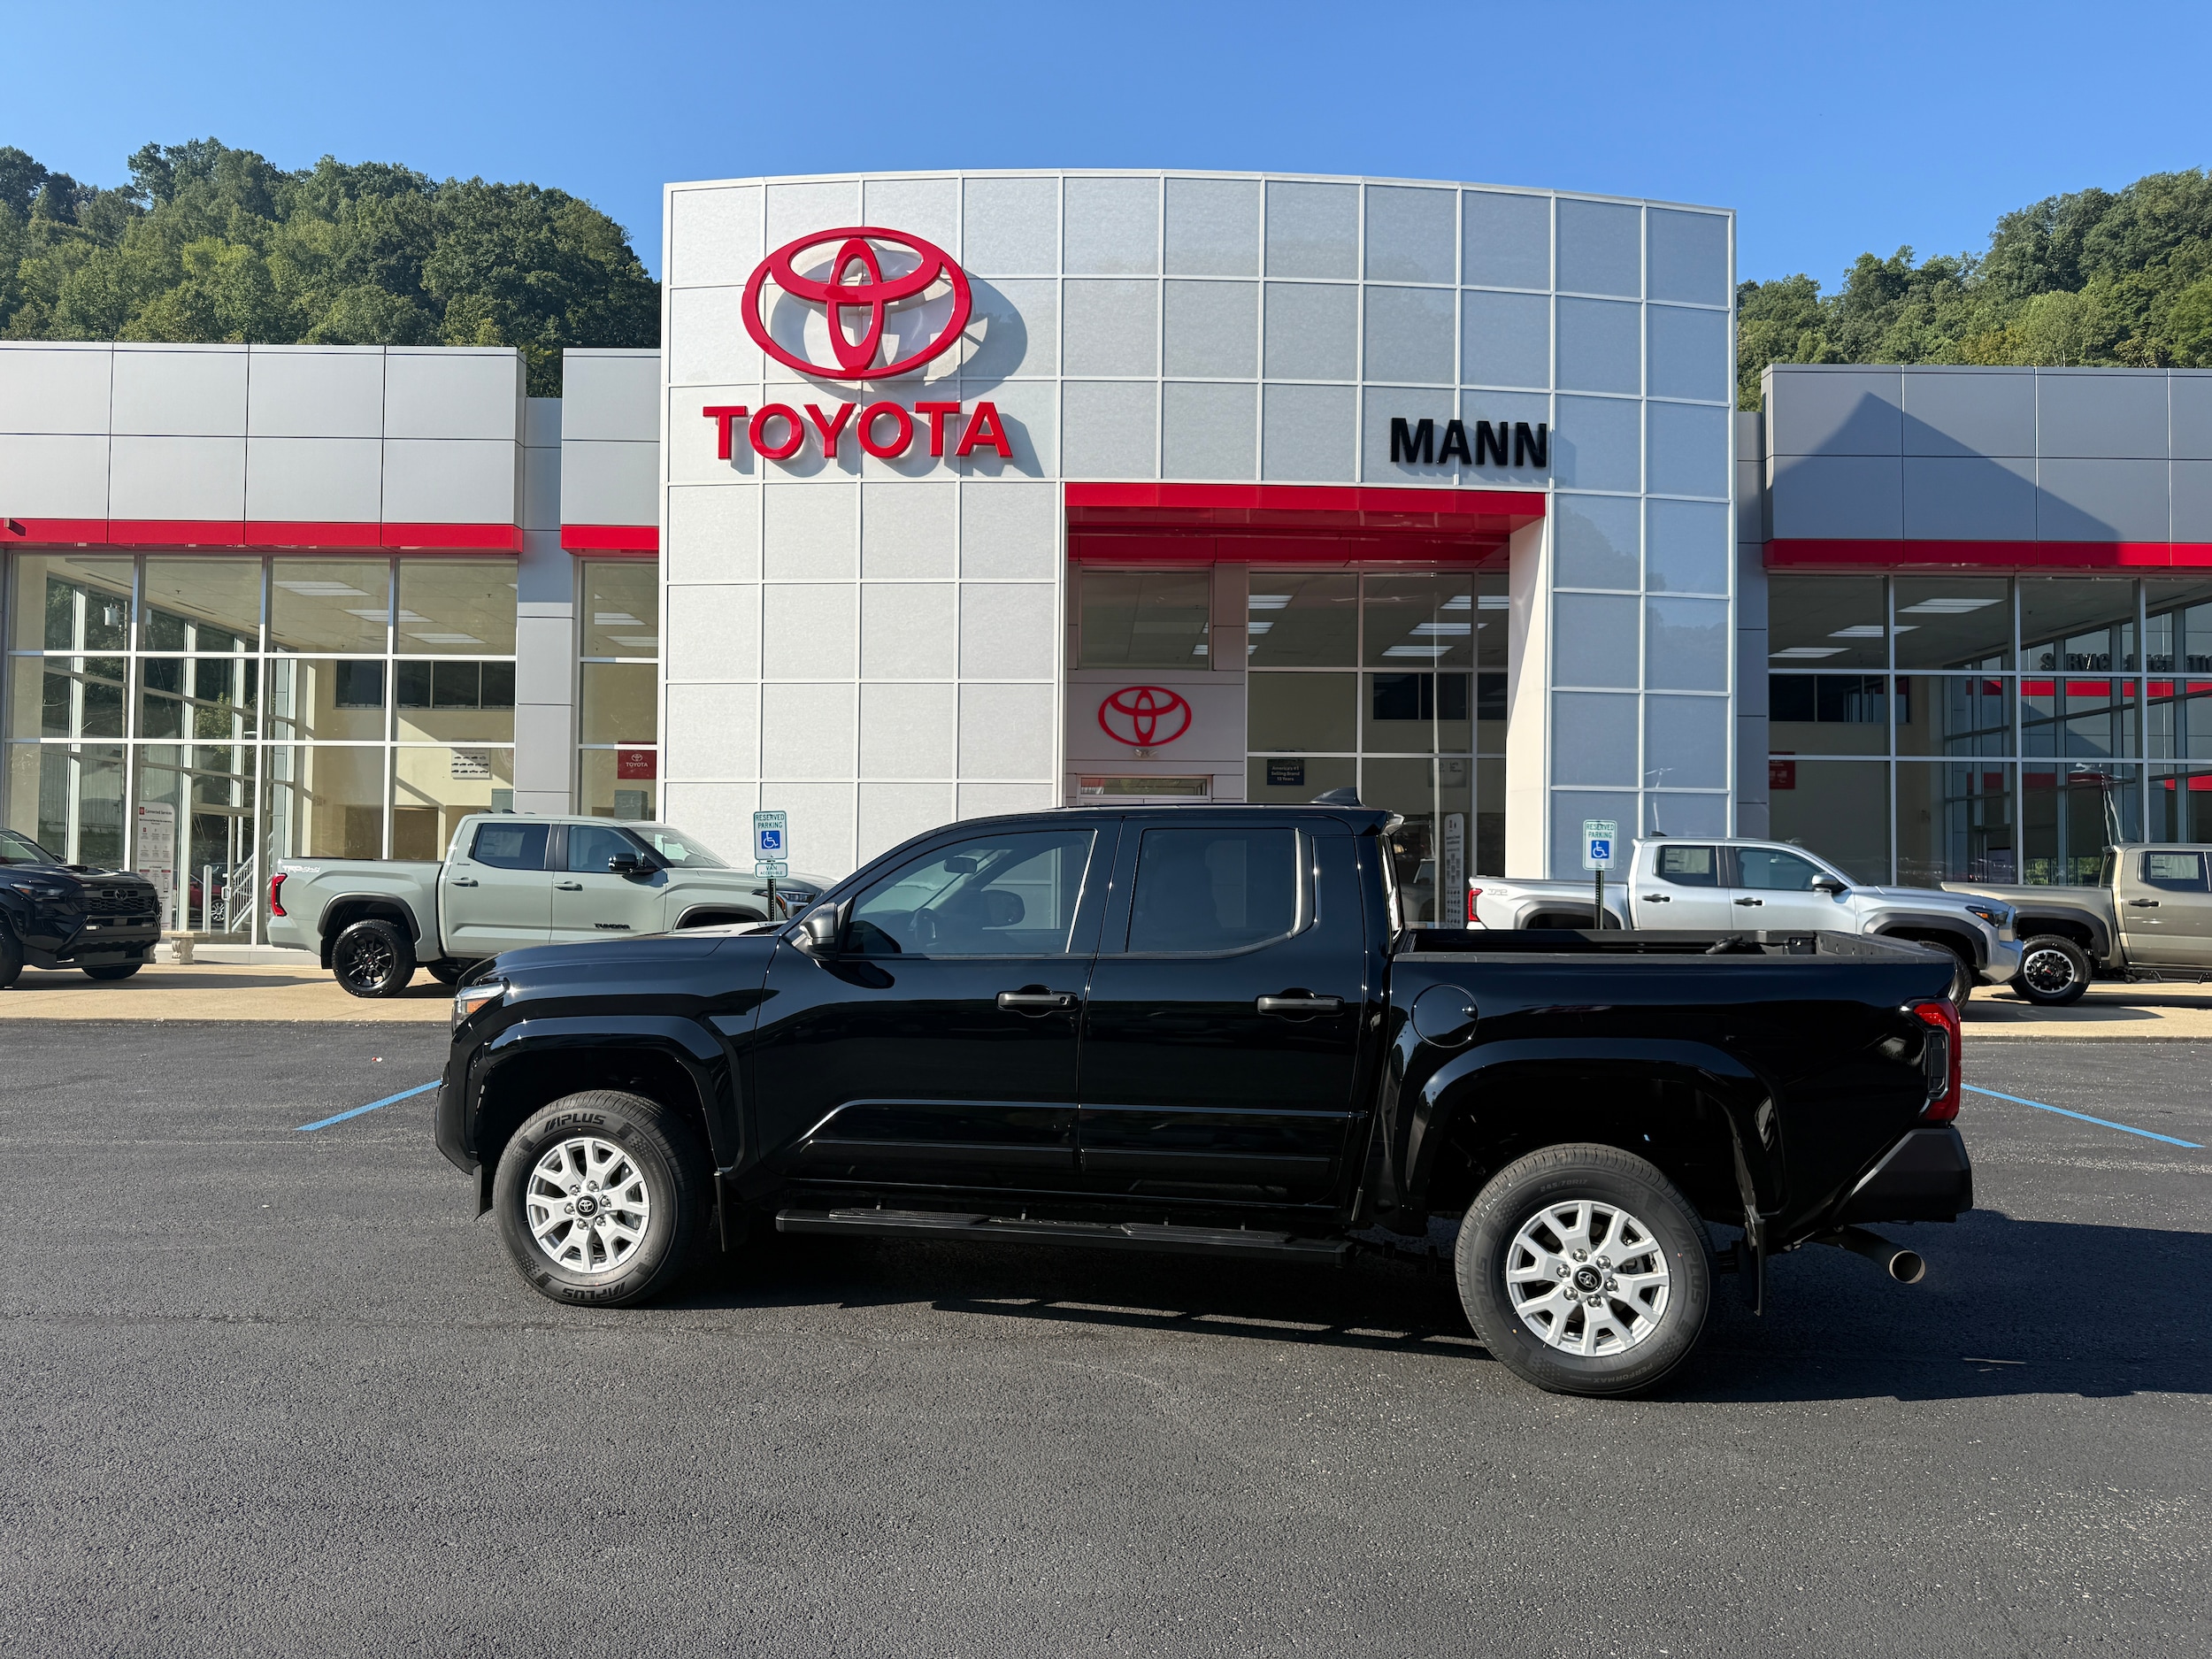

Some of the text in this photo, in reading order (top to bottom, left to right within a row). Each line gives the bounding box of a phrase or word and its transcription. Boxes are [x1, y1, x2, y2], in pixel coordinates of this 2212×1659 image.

[703, 401, 1013, 462] TOYOTA
[1390, 417, 1548, 468] MANN
[1593, 1362, 1654, 1384] PERFORMAX
